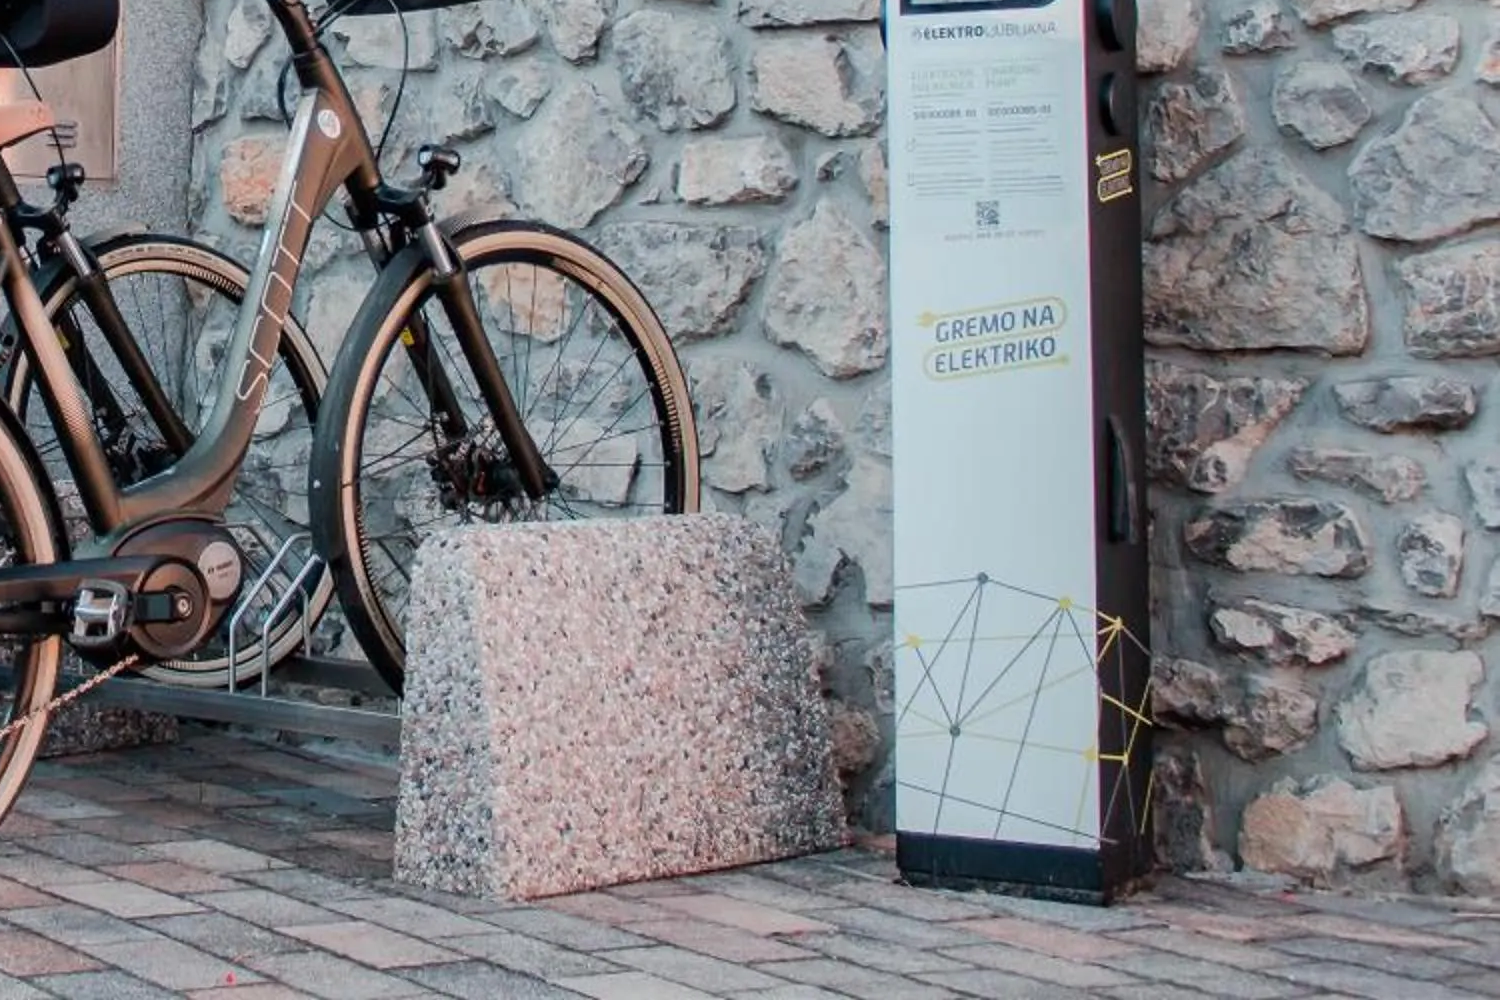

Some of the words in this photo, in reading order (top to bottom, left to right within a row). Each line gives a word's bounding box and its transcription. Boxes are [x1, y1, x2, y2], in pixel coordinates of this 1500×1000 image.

[935, 311, 1016, 343] GREMO
[1023, 304, 1055, 329] NA
[935, 336, 1056, 374] ELEKTRIKO
